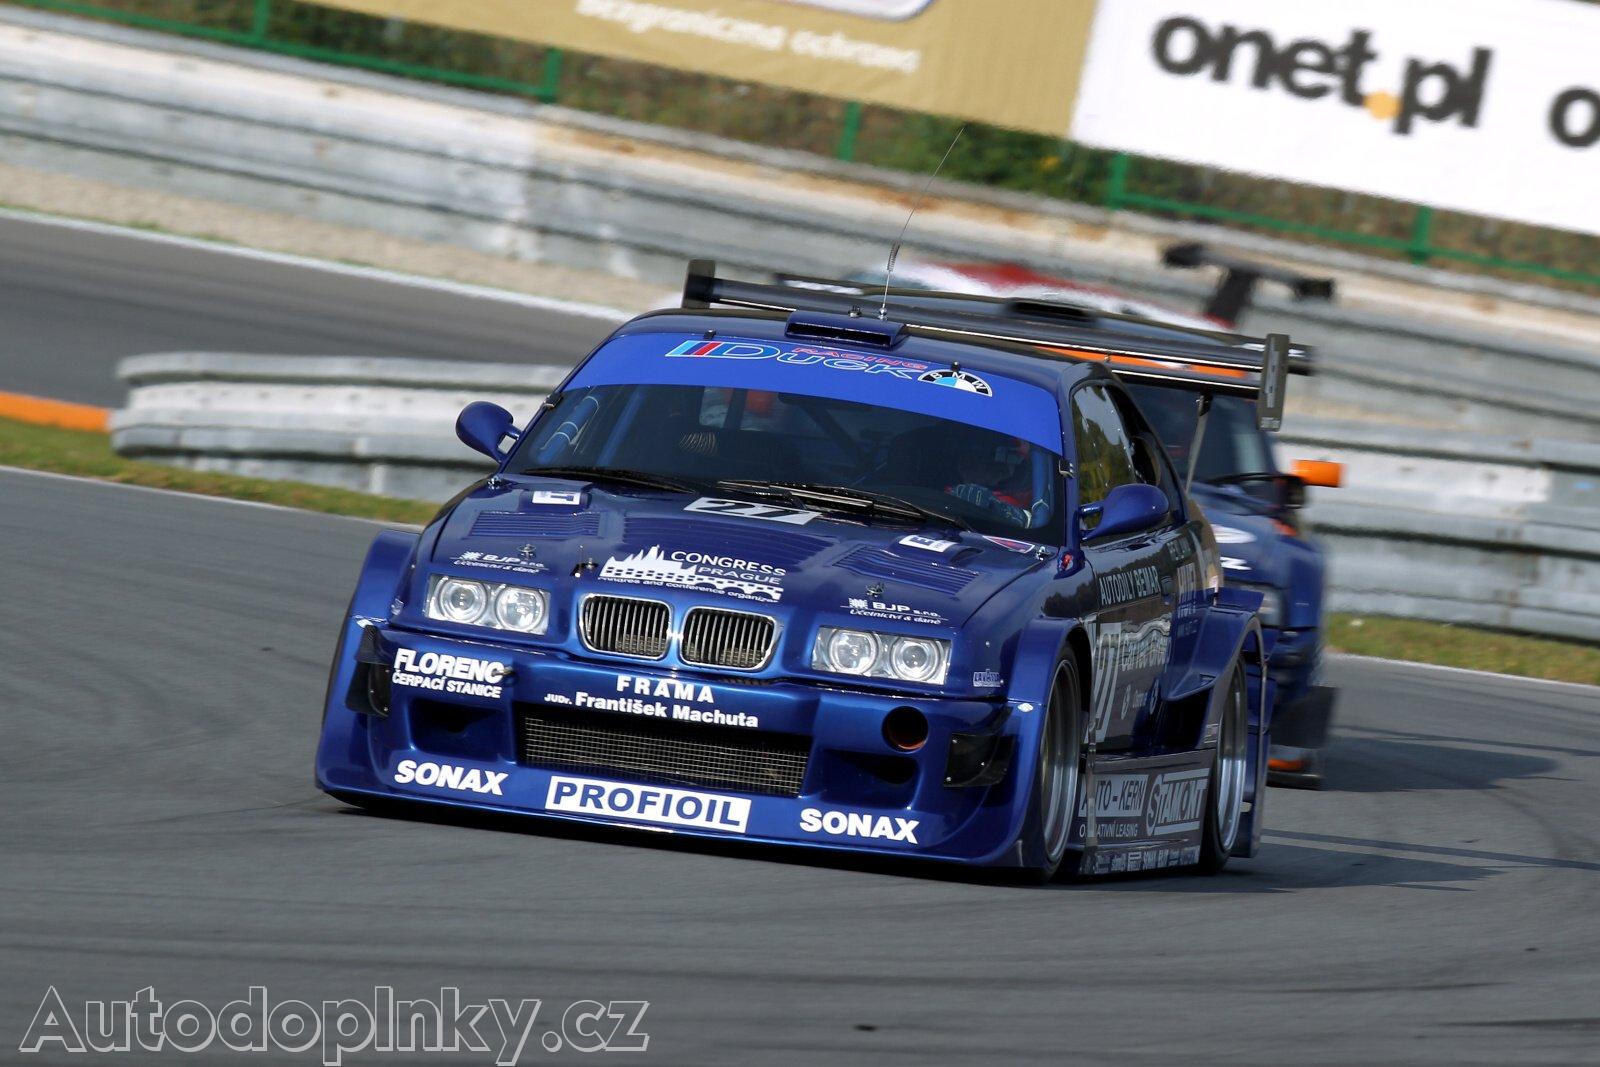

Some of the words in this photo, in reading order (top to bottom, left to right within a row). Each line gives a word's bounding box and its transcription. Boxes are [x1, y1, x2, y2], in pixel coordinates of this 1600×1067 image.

[1151, 14, 1493, 136] onet.pl
[791, 346, 928, 371] RACING
[696, 500, 811, 519] 27
[482, 554, 521, 563] BJP
[670, 551, 787, 576] CONGRESS
[698, 566, 782, 586] PRAGUE
[872, 601, 911, 612] BJP
[393, 647, 504, 684] FLORENC
[392, 669, 448, 691] ČERPACÍ
[446, 680, 503, 699] STANICE
[616, 674, 715, 704] FRAMA
[575, 691, 668, 718] František
[672, 704, 759, 728] Machuta
[394, 759, 509, 796] SONAX
[553, 781, 742, 828] PROFIOIL
[800, 807, 920, 845] SONAX
